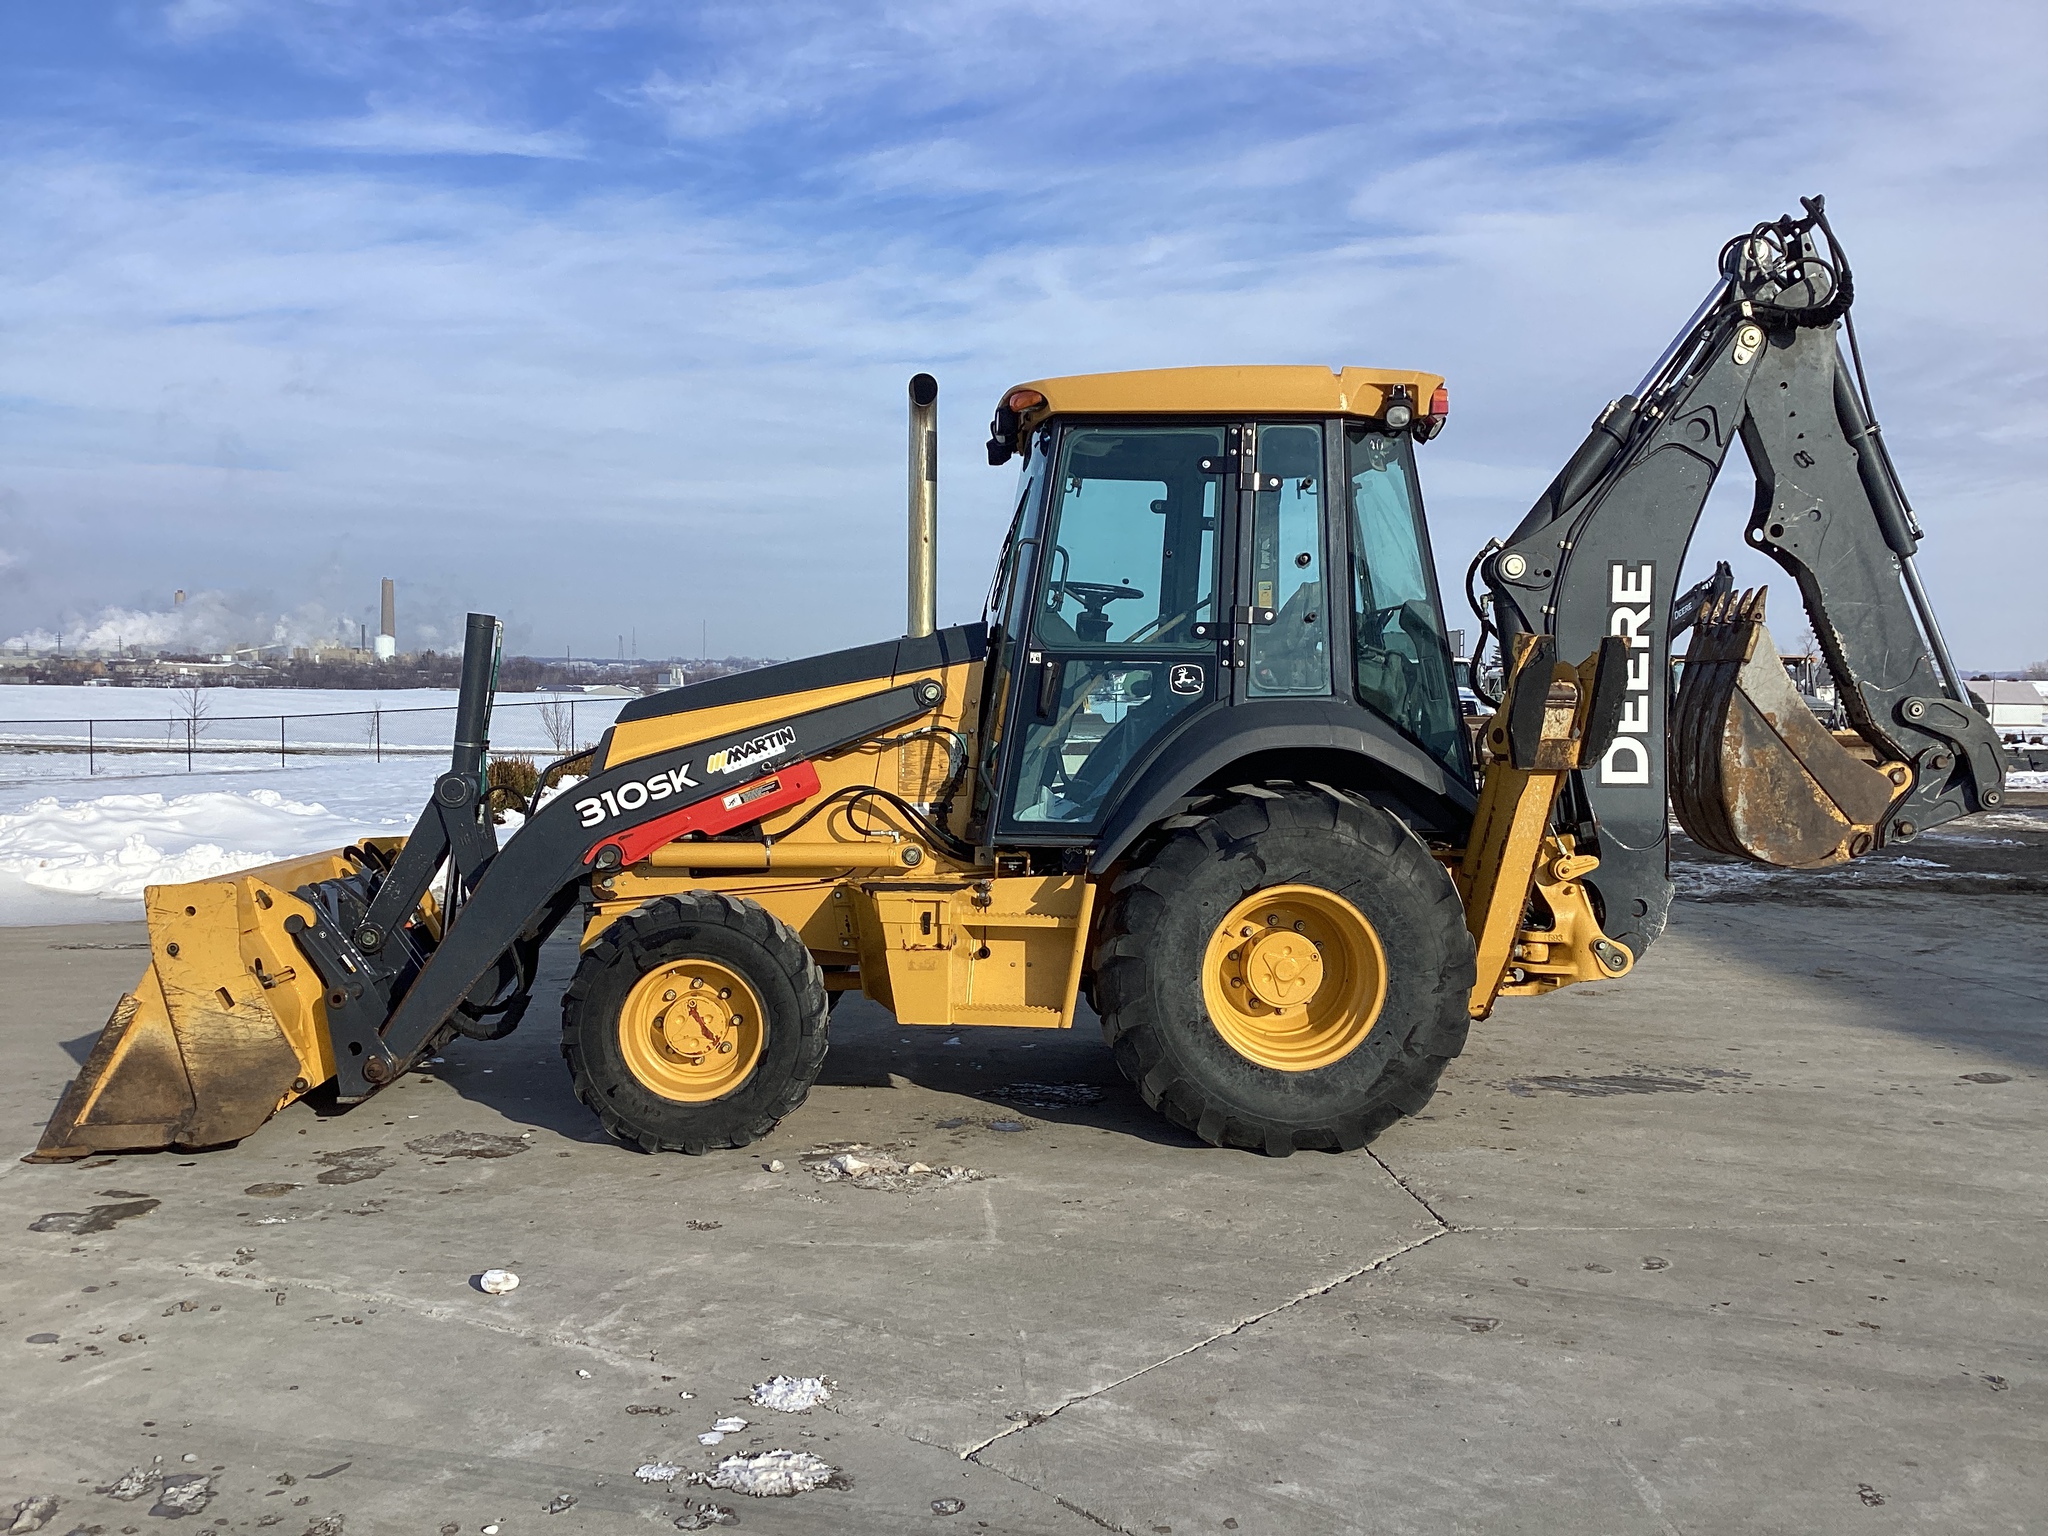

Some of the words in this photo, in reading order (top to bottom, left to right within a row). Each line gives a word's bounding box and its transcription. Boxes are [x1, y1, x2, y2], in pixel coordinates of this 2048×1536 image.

[1674, 601, 1693, 620] DEERE
[1601, 564, 1652, 784] DEERE
[726, 727, 795, 766] MARTIN
[575, 763, 700, 828] 310SK
